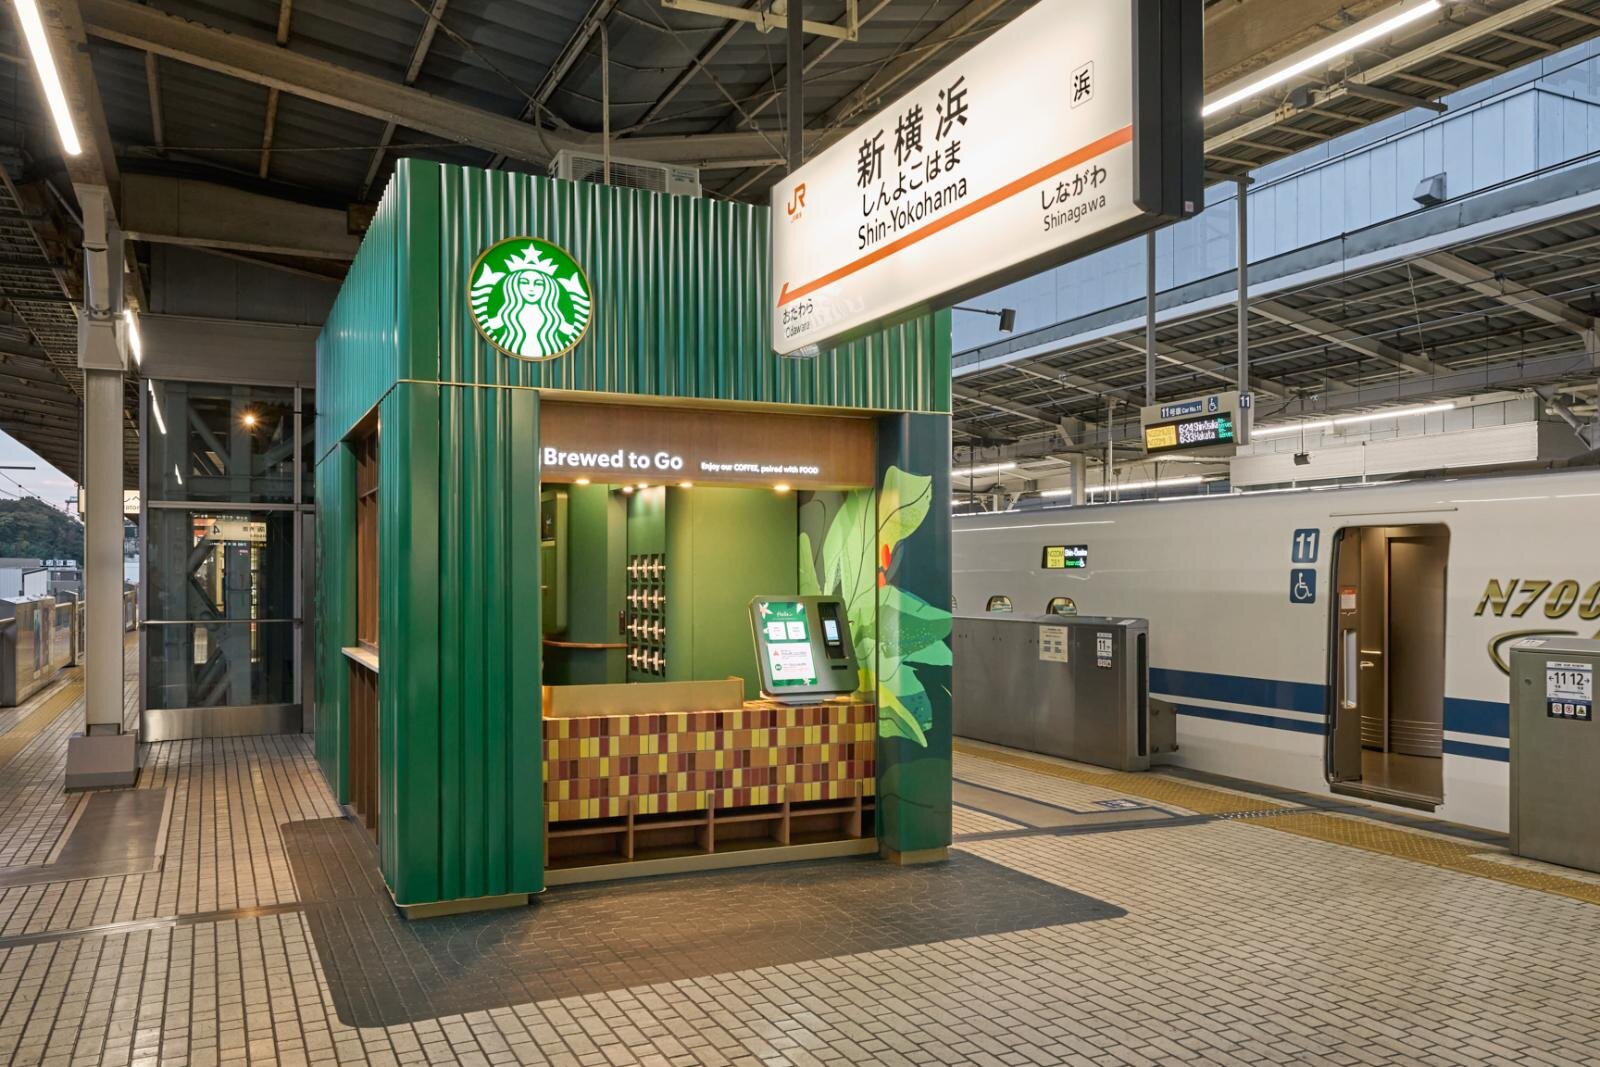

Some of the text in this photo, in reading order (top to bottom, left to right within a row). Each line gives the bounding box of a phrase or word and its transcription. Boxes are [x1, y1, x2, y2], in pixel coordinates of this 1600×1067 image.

[1073, 69, 1090, 102] 浜
[857, 75, 968, 188] 新横浜
[862, 140, 961, 217] しんよこはま
[1041, 165, 1107, 210] しながわ
[787, 182, 806, 216] JR
[858, 177, 967, 250] Shin-Yokohama
[1044, 194, 1106, 231] Shinagawa
[1240, 396, 1250, 407] 11
[544, 447, 683, 470] Brewed to Go
[700, 462, 720, 472] Enjoy
[760, 465, 782, 474] paired
[784, 465, 798, 474] with
[799, 466, 819, 474] FOOD
[1296, 533, 1316, 559] 11
[1554, 672, 1584, 686] 11 12
